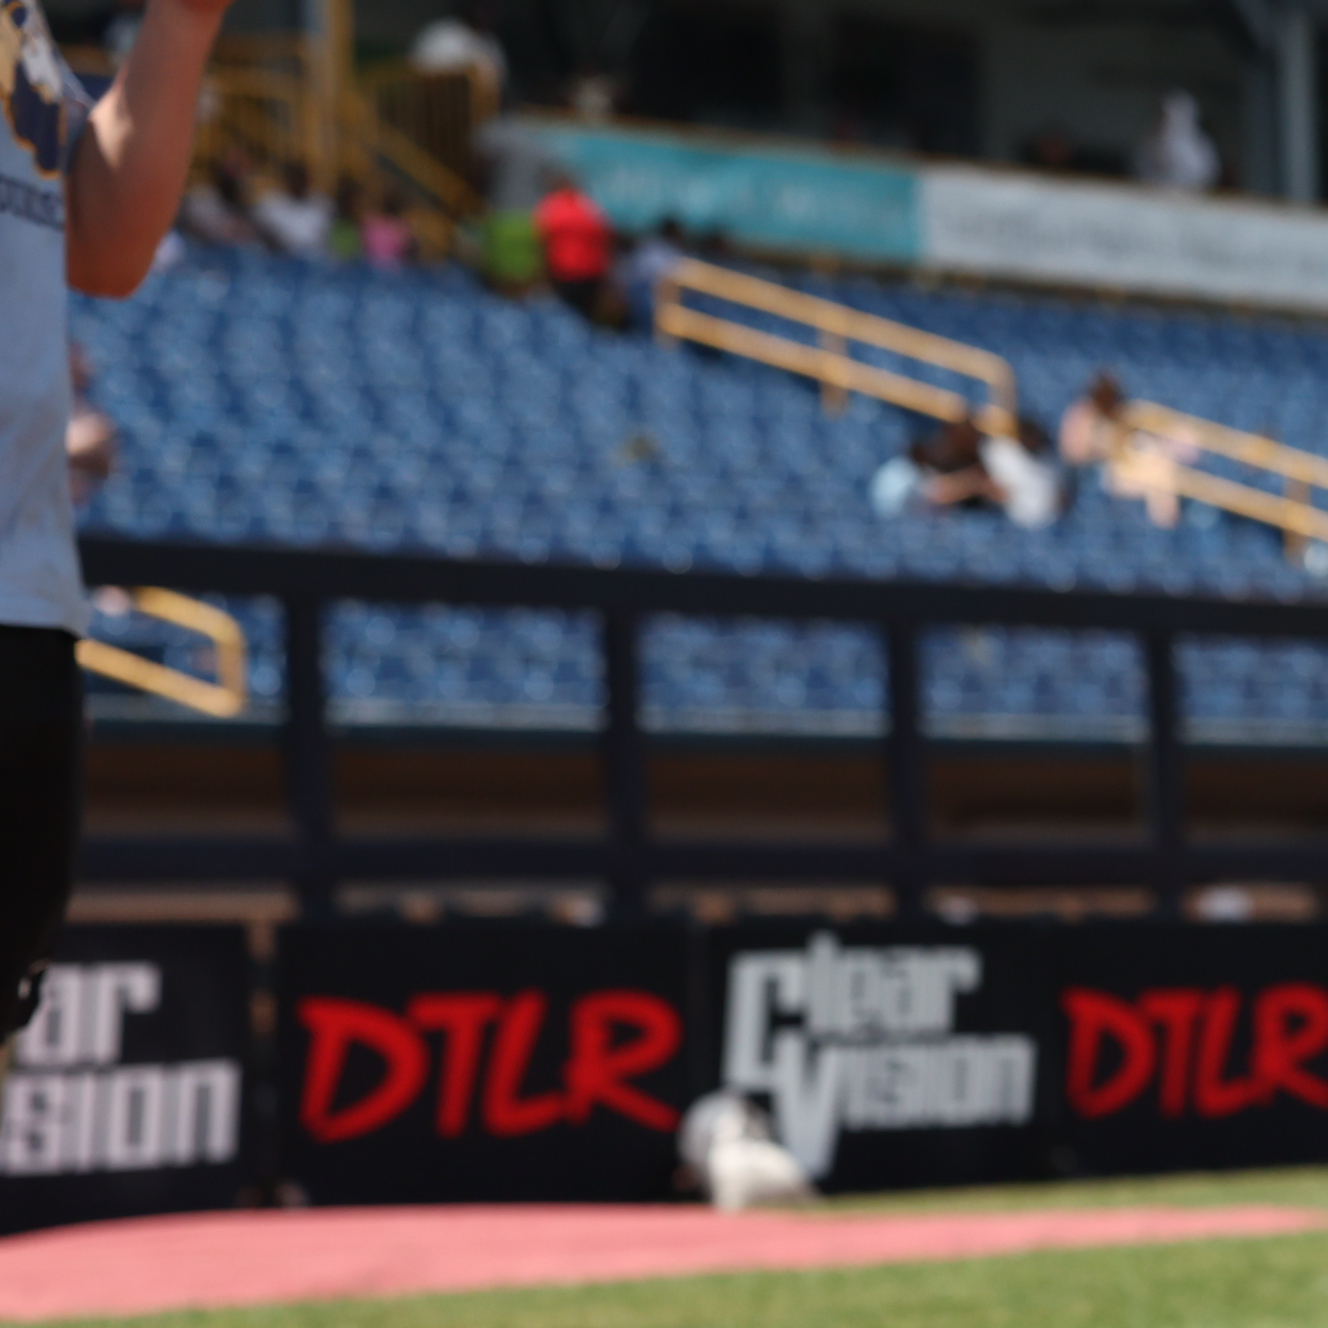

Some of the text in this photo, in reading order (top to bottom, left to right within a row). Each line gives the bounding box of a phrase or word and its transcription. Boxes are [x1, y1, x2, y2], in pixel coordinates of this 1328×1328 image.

[299, 990, 682, 1142] DTLR
[725, 929, 985, 1092] Clear
[770, 1030, 1036, 1181] Vision
